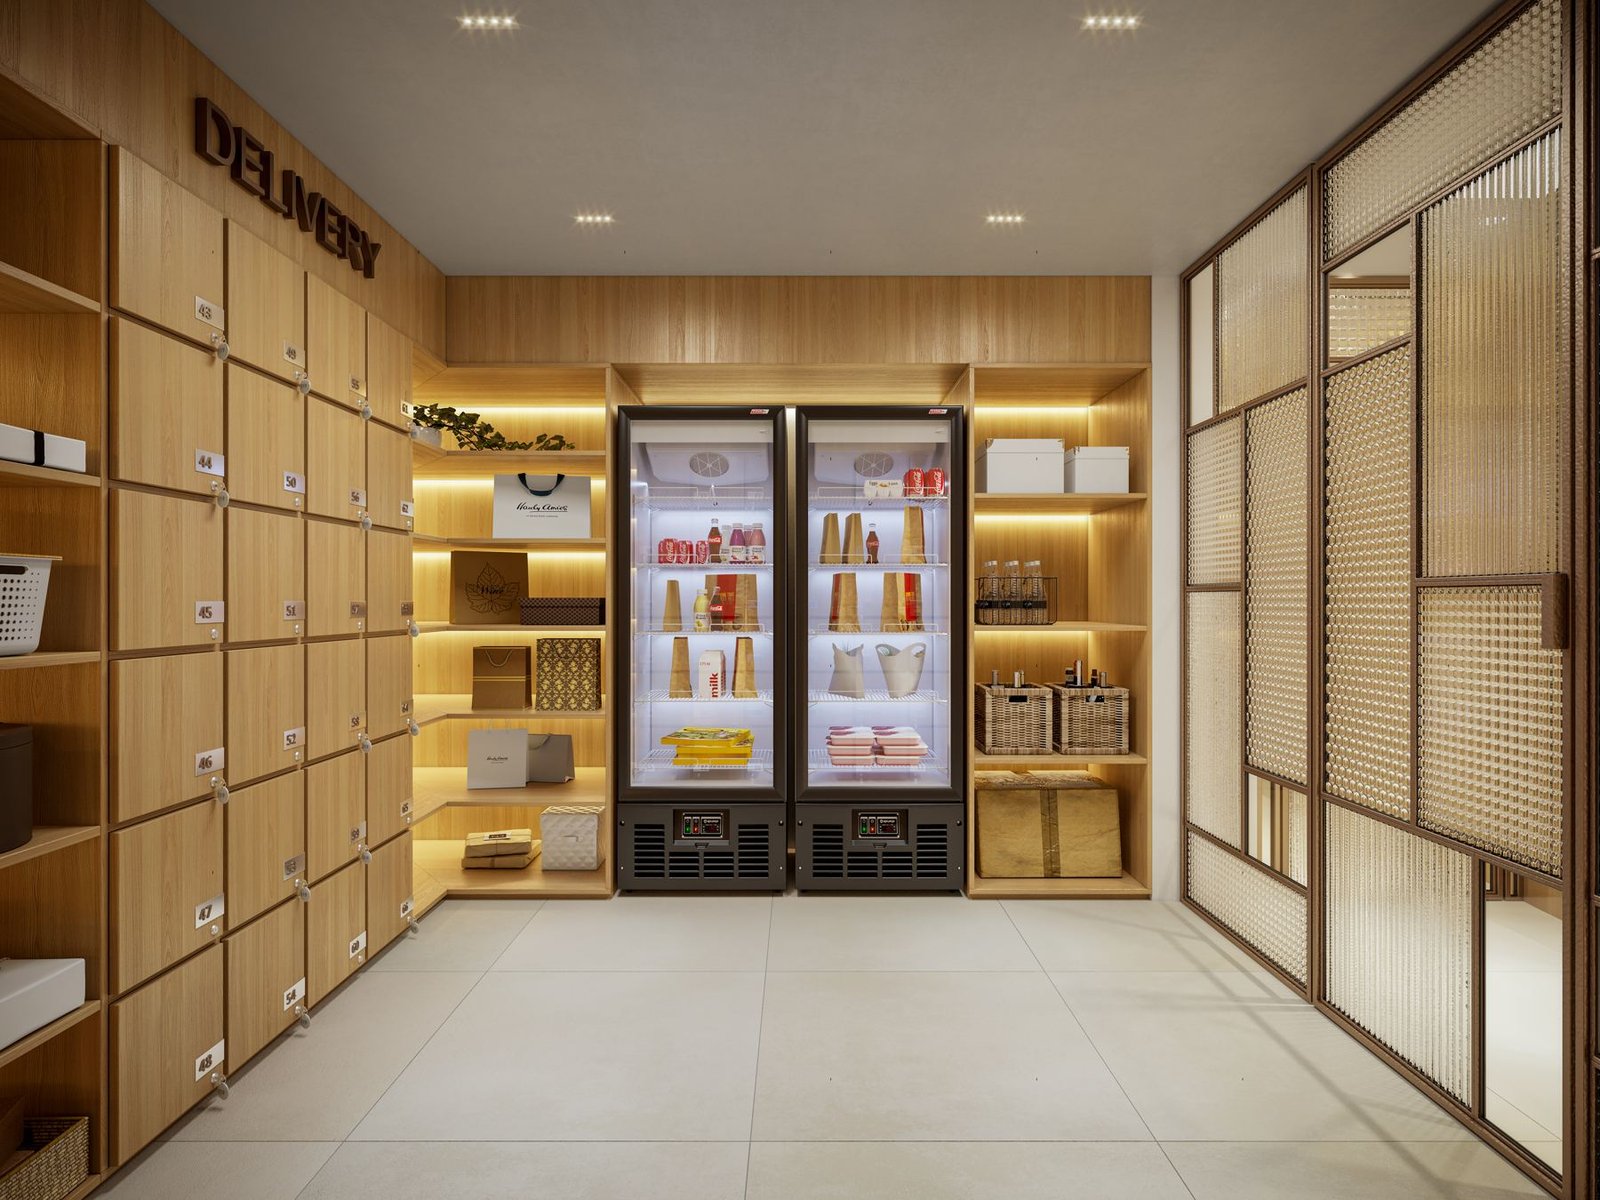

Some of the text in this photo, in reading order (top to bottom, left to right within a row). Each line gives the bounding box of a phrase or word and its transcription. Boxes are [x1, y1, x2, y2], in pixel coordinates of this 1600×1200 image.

[194, 97, 382, 279] DELIVERY
[198, 303, 213, 320] 43
[198, 455, 213, 470] 44
[285, 475, 297, 489] 50
[198, 606, 213, 619] 45
[285, 605, 297, 617] 51
[709, 672, 719, 698] milk
[285, 733, 297, 746] 52
[198, 755, 213, 770] 46
[198, 904, 213, 921] 47
[286, 989, 297, 1006] 54
[198, 1054, 213, 1073] 48
